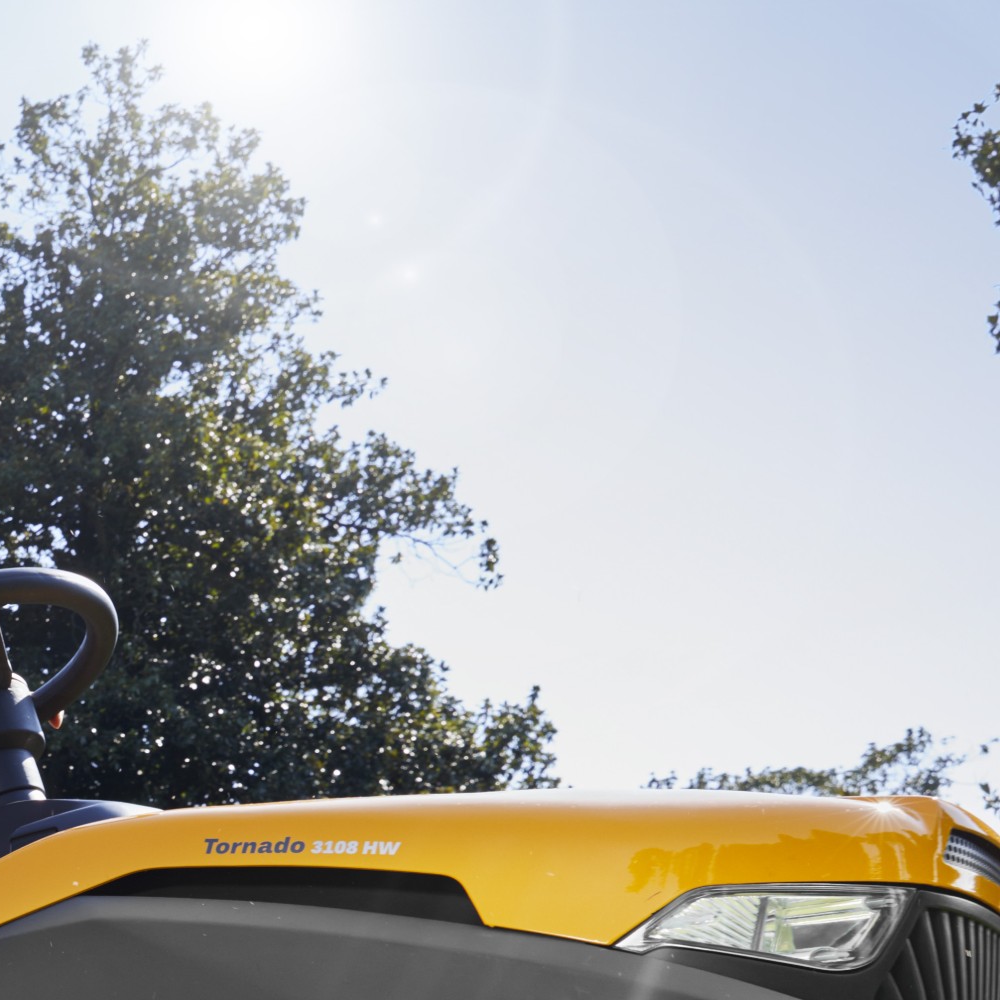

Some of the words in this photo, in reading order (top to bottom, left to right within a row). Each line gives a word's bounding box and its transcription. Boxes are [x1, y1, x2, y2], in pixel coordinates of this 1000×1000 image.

[204, 837, 305, 855] Tornado
[310, 840, 358, 855] 3108
[362, 841, 402, 856] HW
